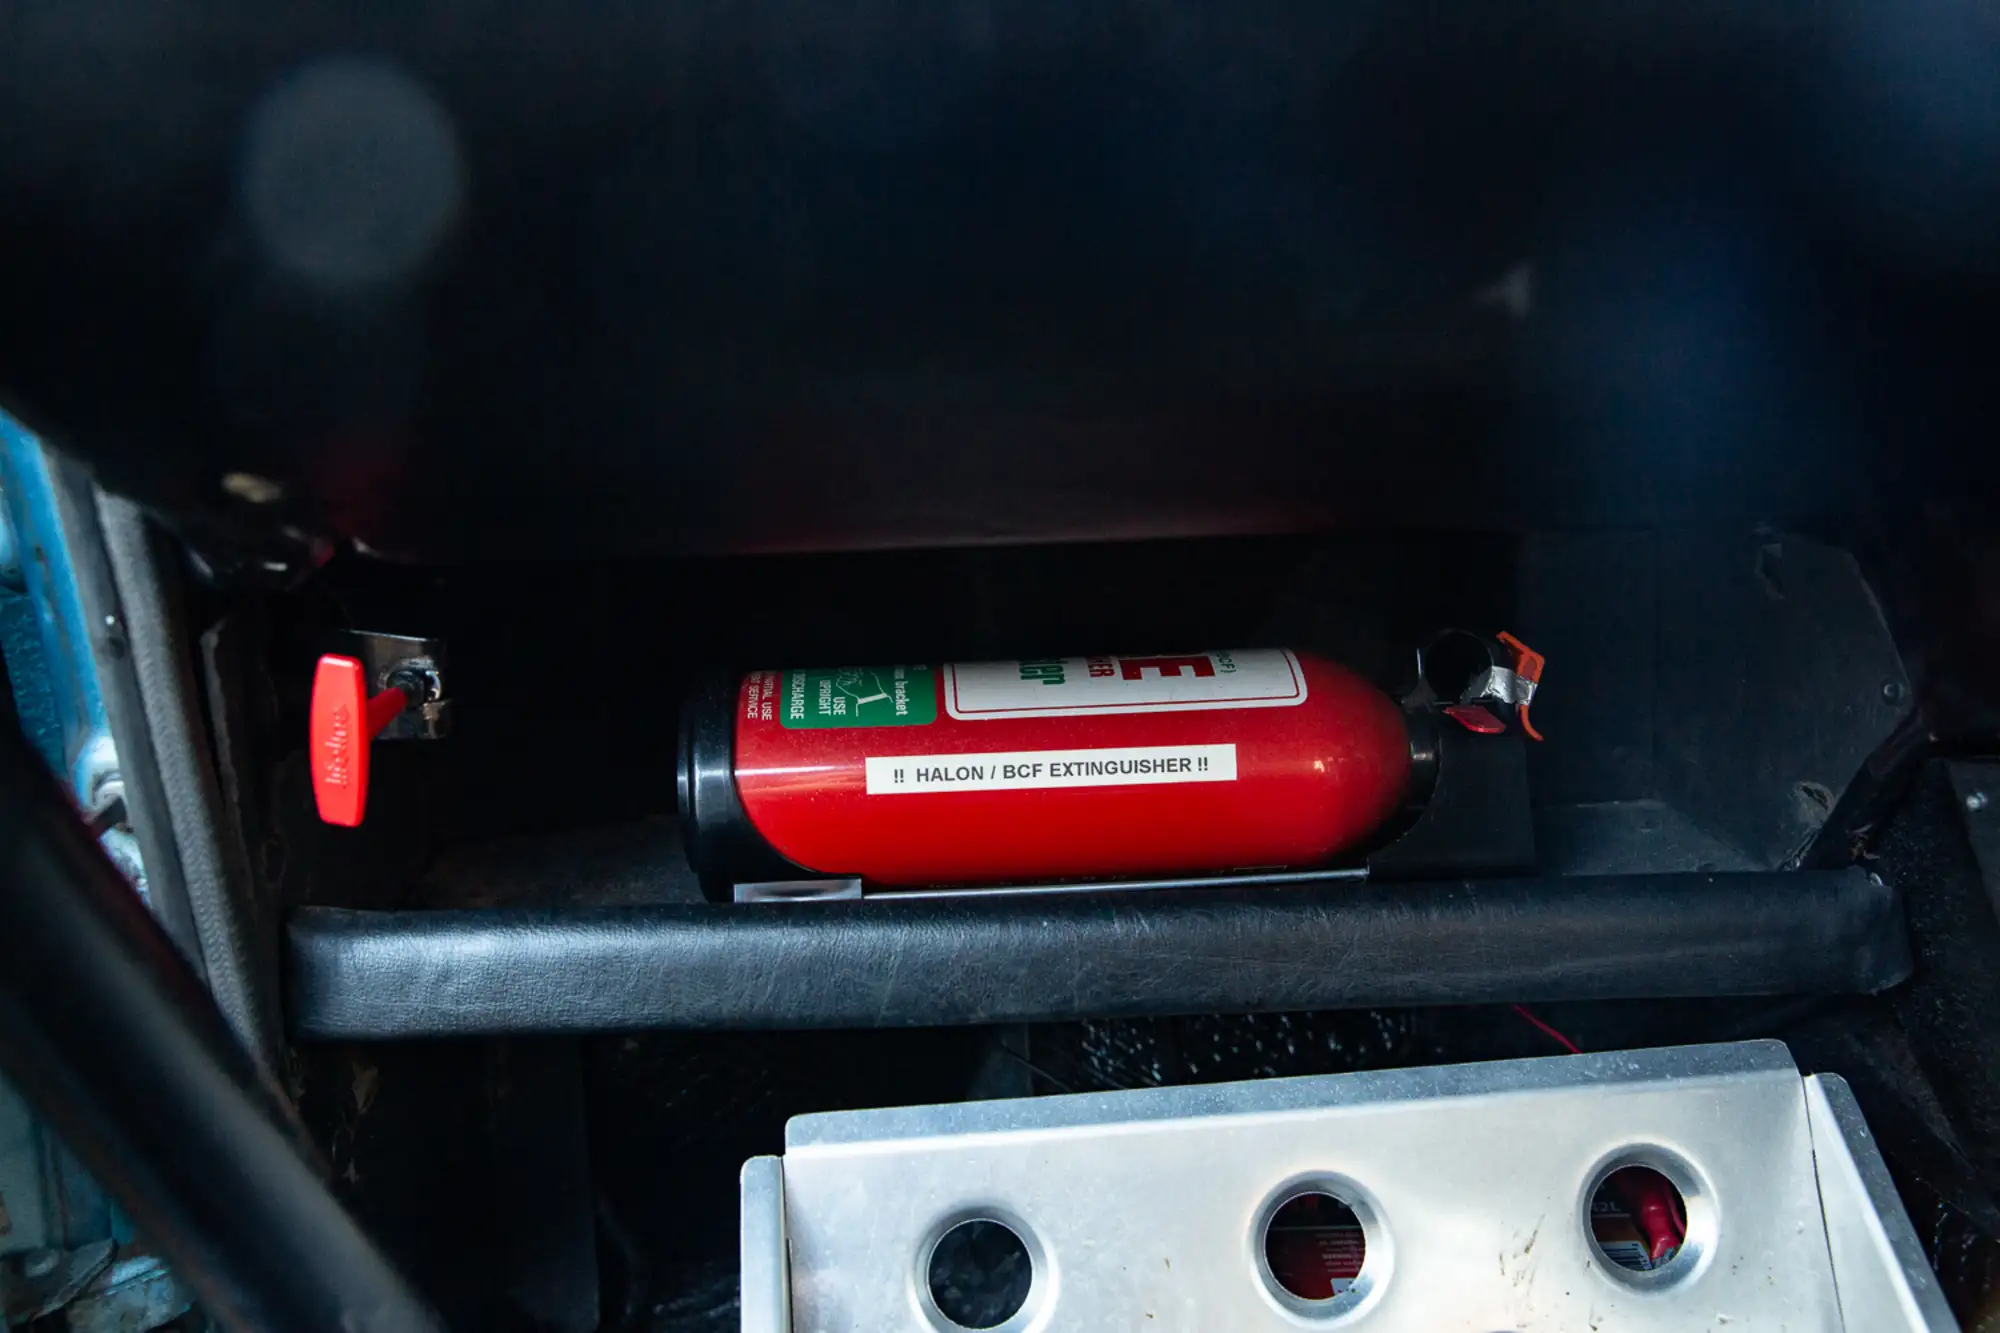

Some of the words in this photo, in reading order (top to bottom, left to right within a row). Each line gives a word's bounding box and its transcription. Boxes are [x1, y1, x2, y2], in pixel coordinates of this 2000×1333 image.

[747, 684, 760, 719] SERVICE
[762, 701, 772, 721] USE
[818, 679, 831, 716] UPRIGHT
[833, 696, 846, 715] USE
[896, 681, 910, 716] bracket
[894, 769, 904, 783] !!
[916, 766, 984, 783] HALON
[990, 765, 996, 780] /
[1003, 763, 1043, 779] BCF
[1050, 758, 1192, 777] EXTINGUISHER
[1198, 757, 1208, 771] !!
